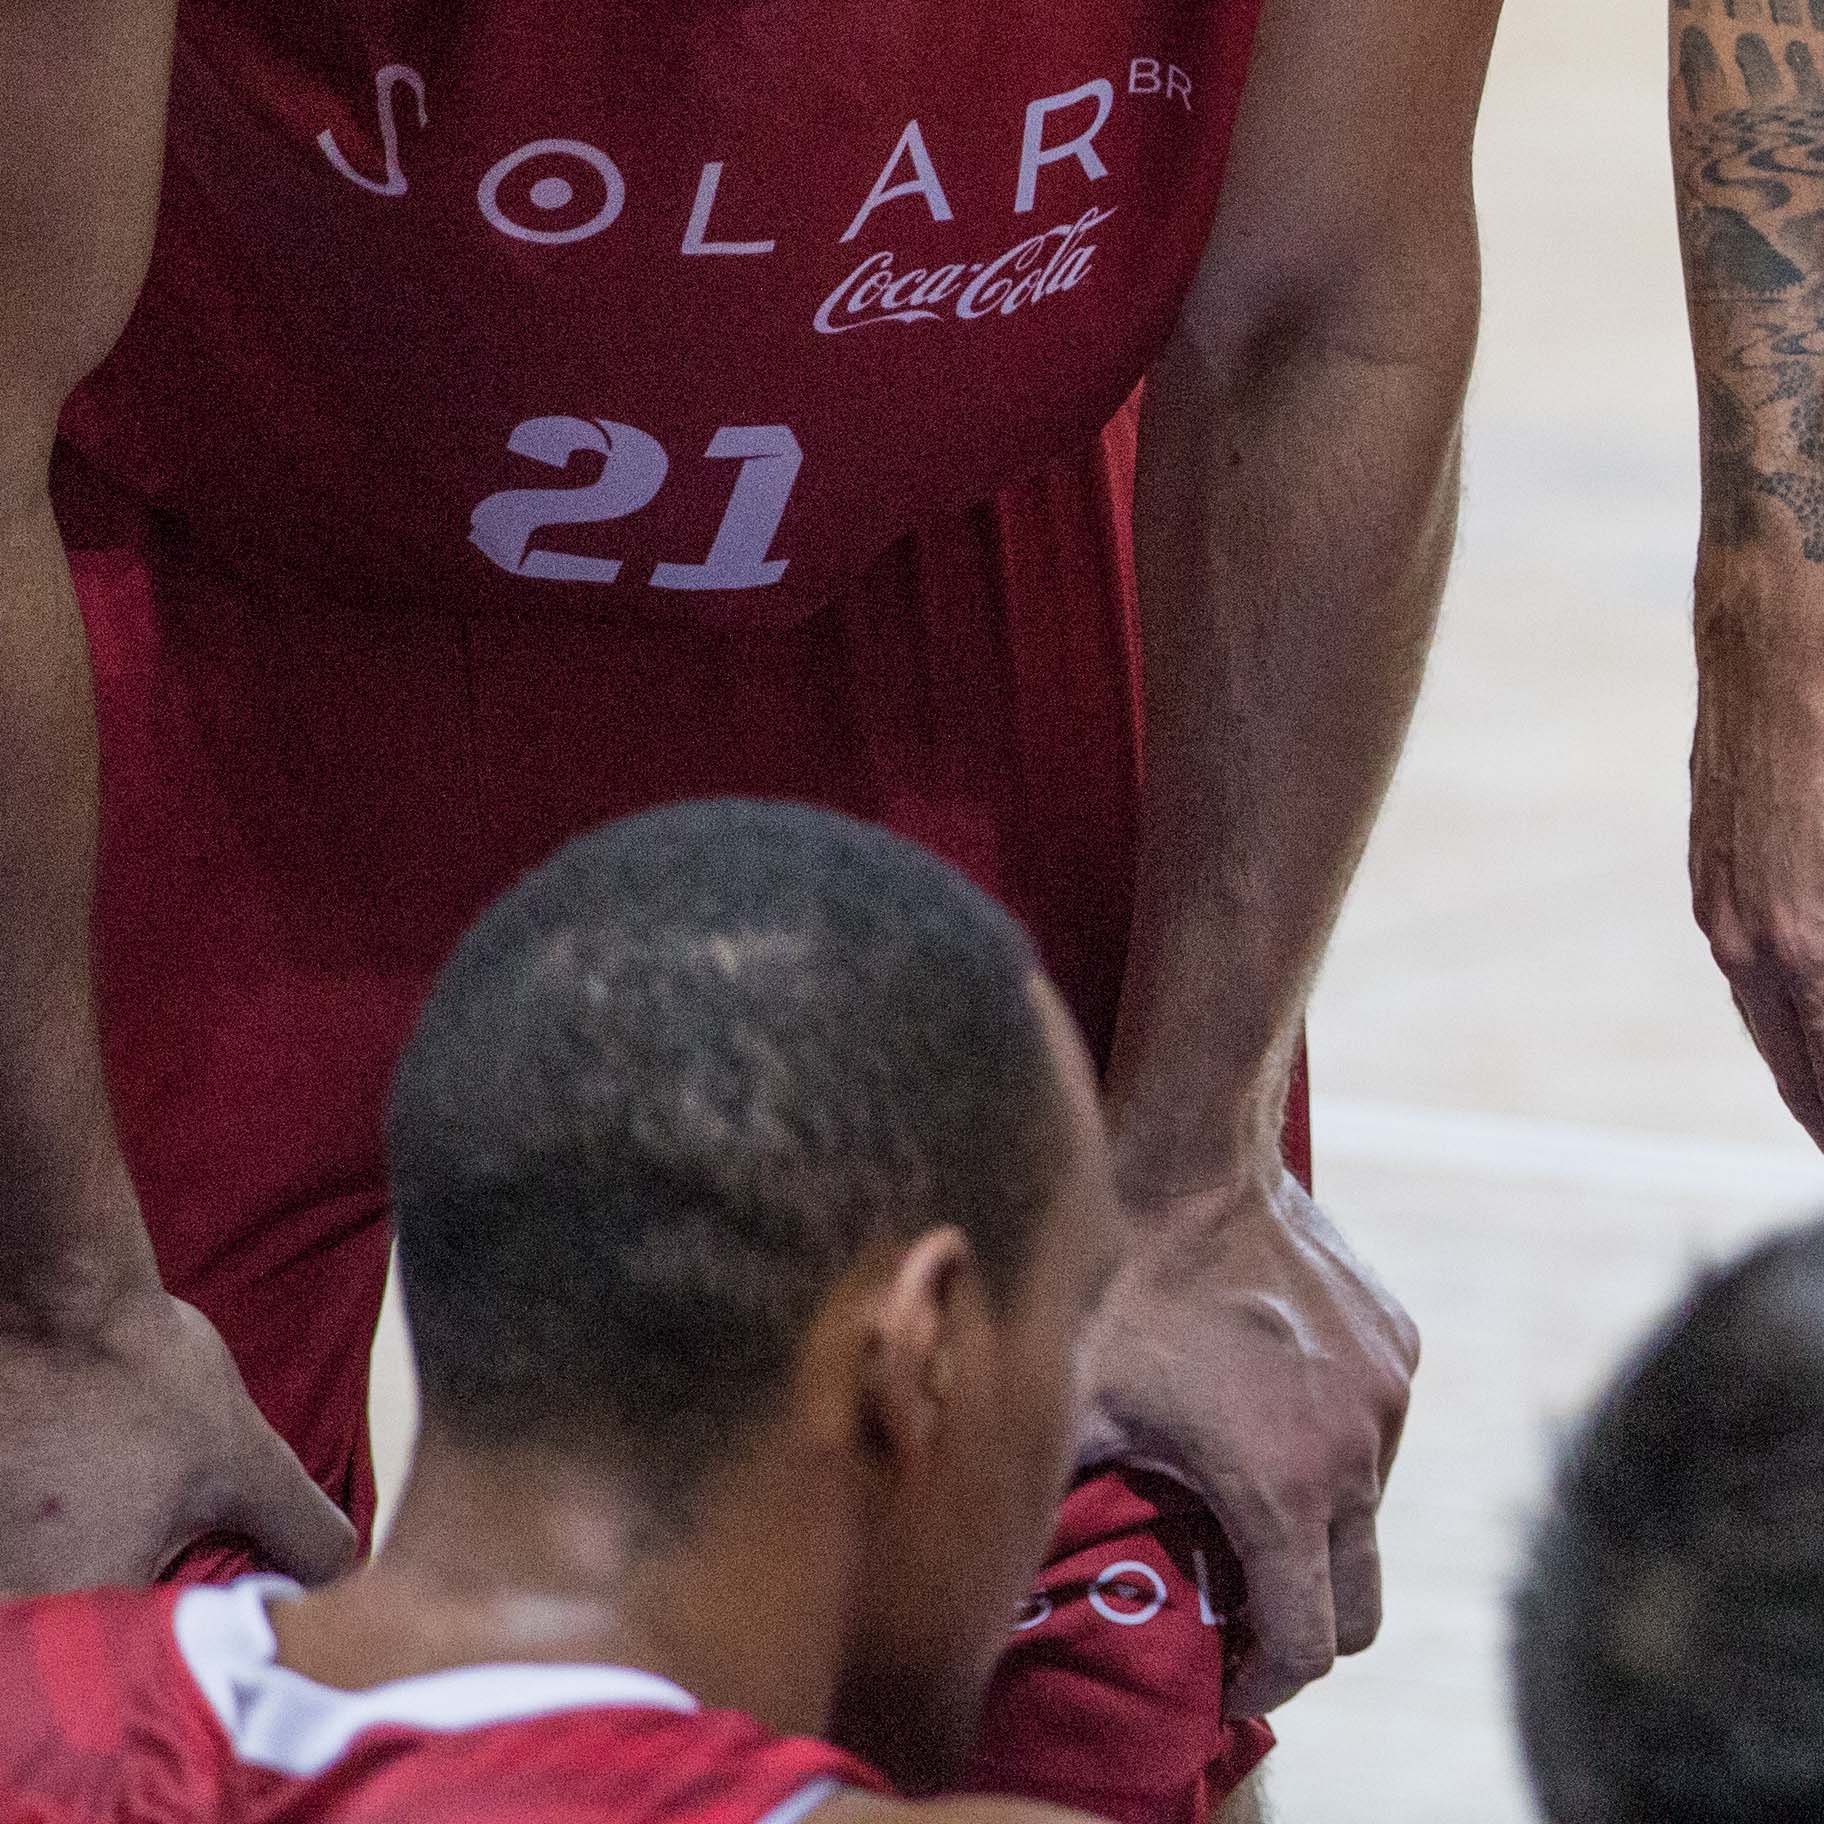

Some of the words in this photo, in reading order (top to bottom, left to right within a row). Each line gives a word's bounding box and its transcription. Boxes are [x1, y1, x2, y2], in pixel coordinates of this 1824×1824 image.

[316, 62, 1113, 256] SOLAR
[1128, 56, 1196, 111] BR
[812, 206, 1117, 335] Coca-Cola
[467, 414, 804, 591] 21
